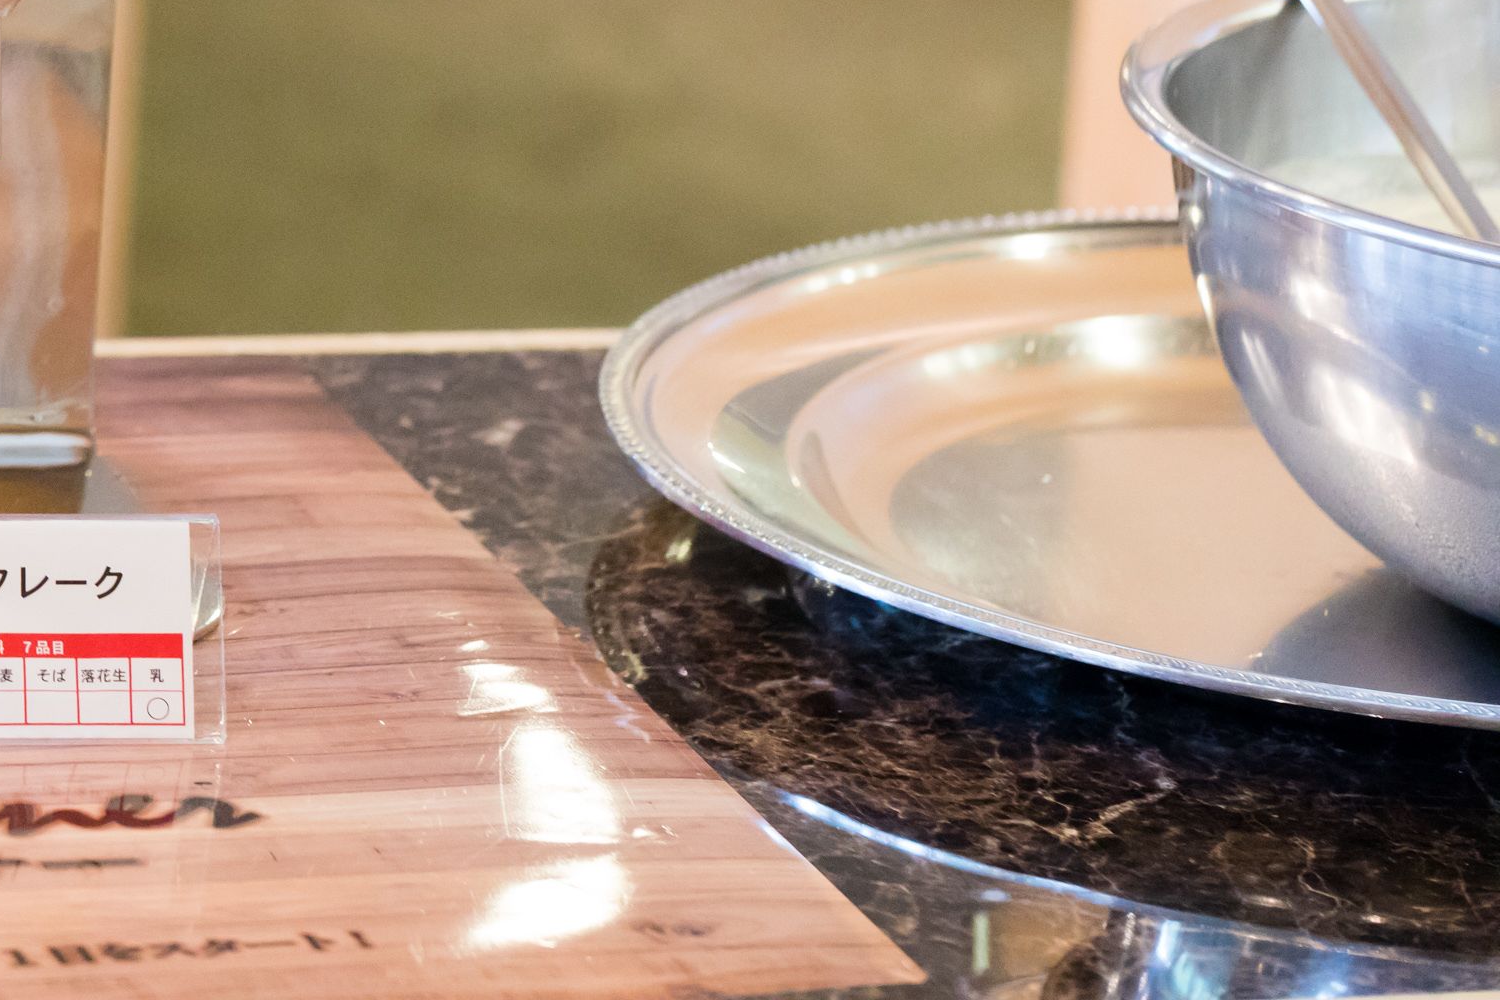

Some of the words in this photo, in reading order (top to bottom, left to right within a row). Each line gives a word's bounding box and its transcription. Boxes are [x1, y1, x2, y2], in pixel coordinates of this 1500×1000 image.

[23, 640, 64, 655] 7品目
[37, 668, 67, 683] そば
[81, 668, 127, 684] 落花生
[150, 668, 164, 683] 乳
